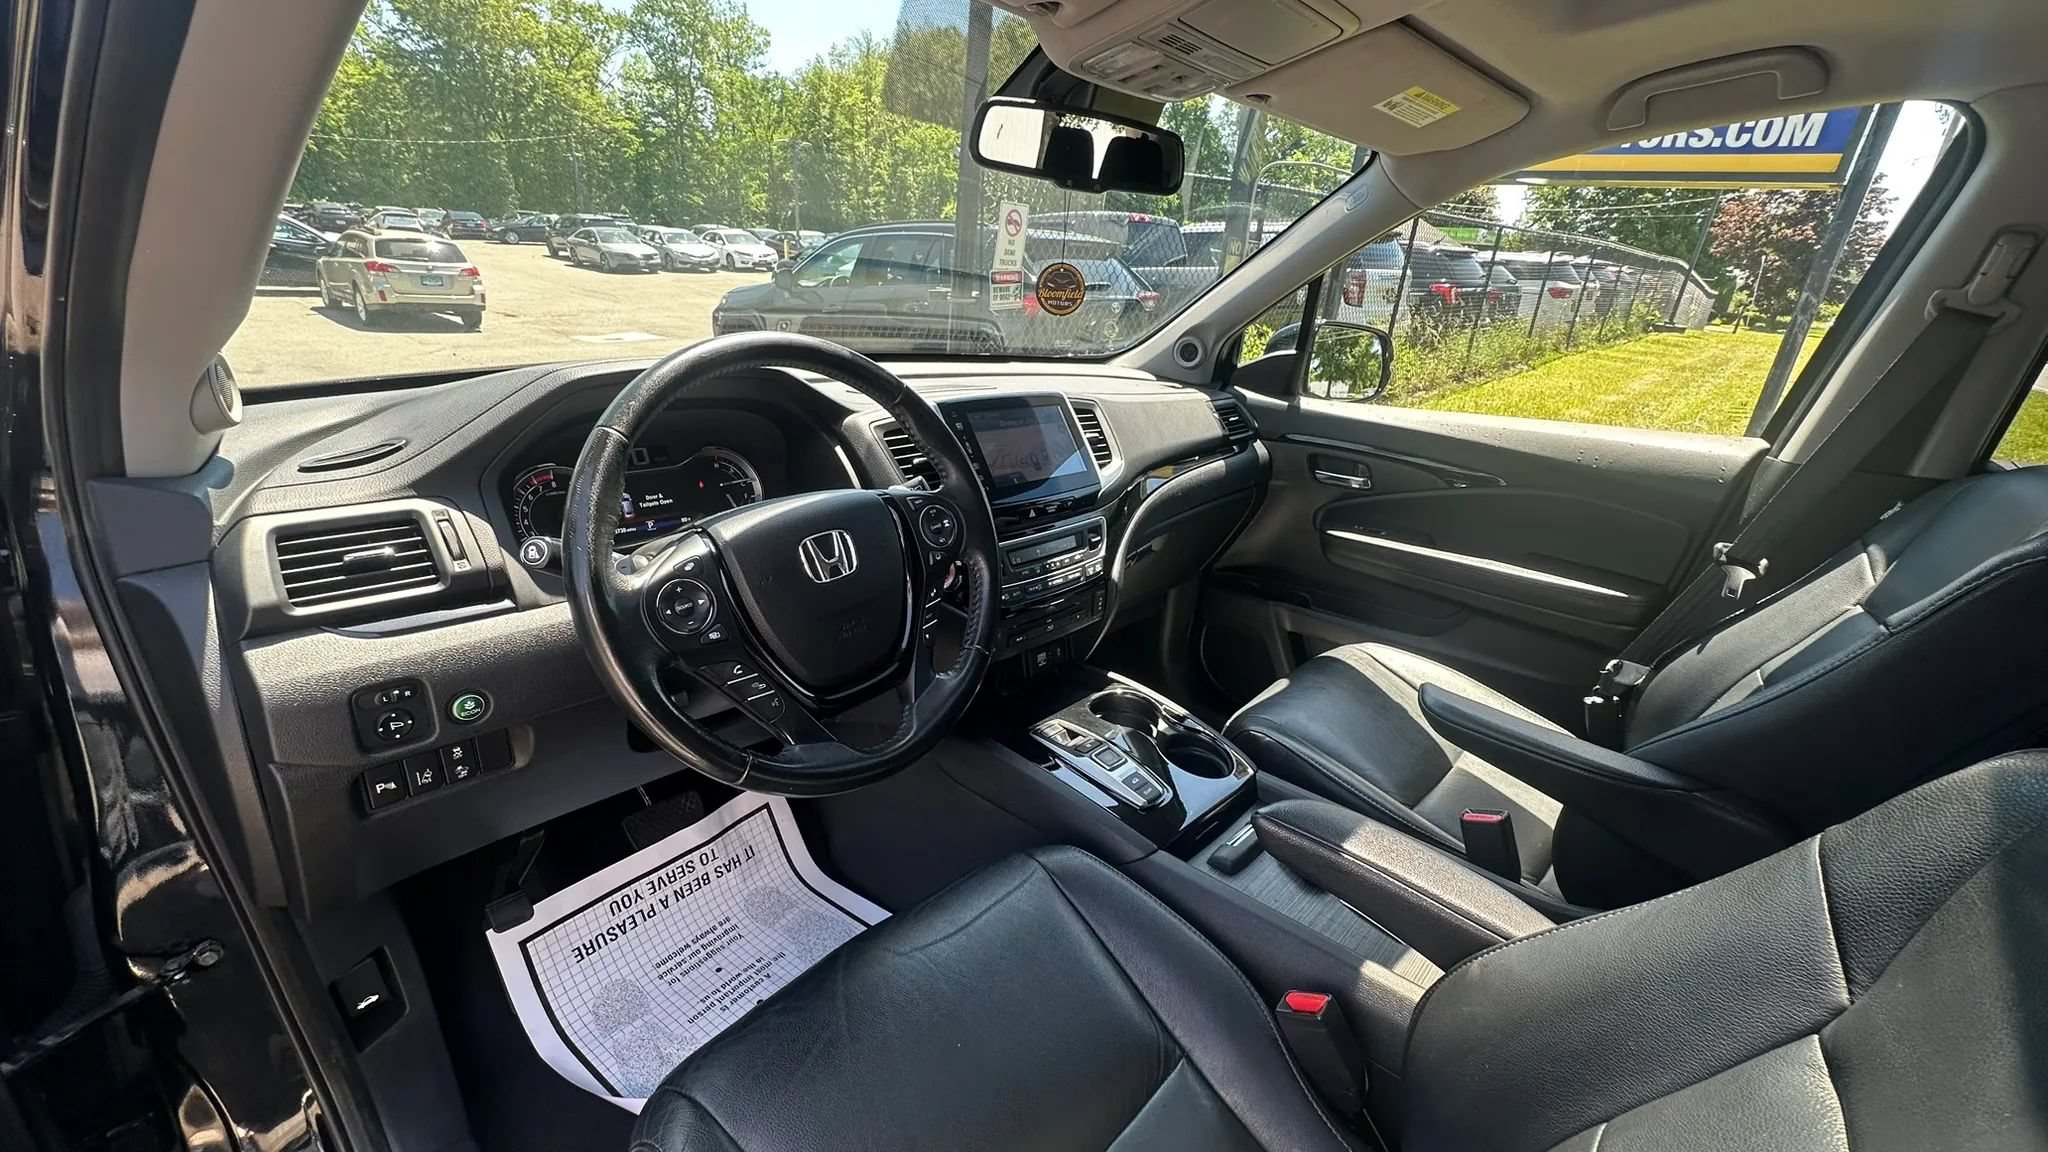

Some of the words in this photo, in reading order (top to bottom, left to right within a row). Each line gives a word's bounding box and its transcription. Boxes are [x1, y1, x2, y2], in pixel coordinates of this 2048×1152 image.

[1621, 113, 1828, 148] S.COM
[1039, 288, 1084, 301] Bloomfield
[461, 708, 481, 717] ECON
[699, 848, 719, 866] TO
[744, 845, 755, 861] IT
[712, 854, 743, 878] HAS
[646, 860, 696, 895] SERVE
[674, 872, 712, 902] BEEN
[610, 889, 643, 916] YOU
[659, 896, 669, 909] A
[718, 916, 731, 927] are
[572, 904, 657, 963] PLEASURE
[691, 927, 718, 944] always
[701, 923, 739, 951] improving
[726, 933, 744, 946] Your
[680, 944, 726, 978] suggestions
[689, 949, 701, 960] our
[755, 956, 764, 964] in
[772, 952, 785, 962] the
[658, 958, 688, 980] service
[743, 962, 756, 974] the
[753, 961, 772, 976] most
[668, 975, 680, 987] for
[715, 974, 753, 1003] important
[720, 973, 742, 989] world
[711, 988, 720, 996] to
[729, 978, 764, 1005] customer
[688, 1001, 715, 1024] person
[720, 1004, 729, 1013] is
